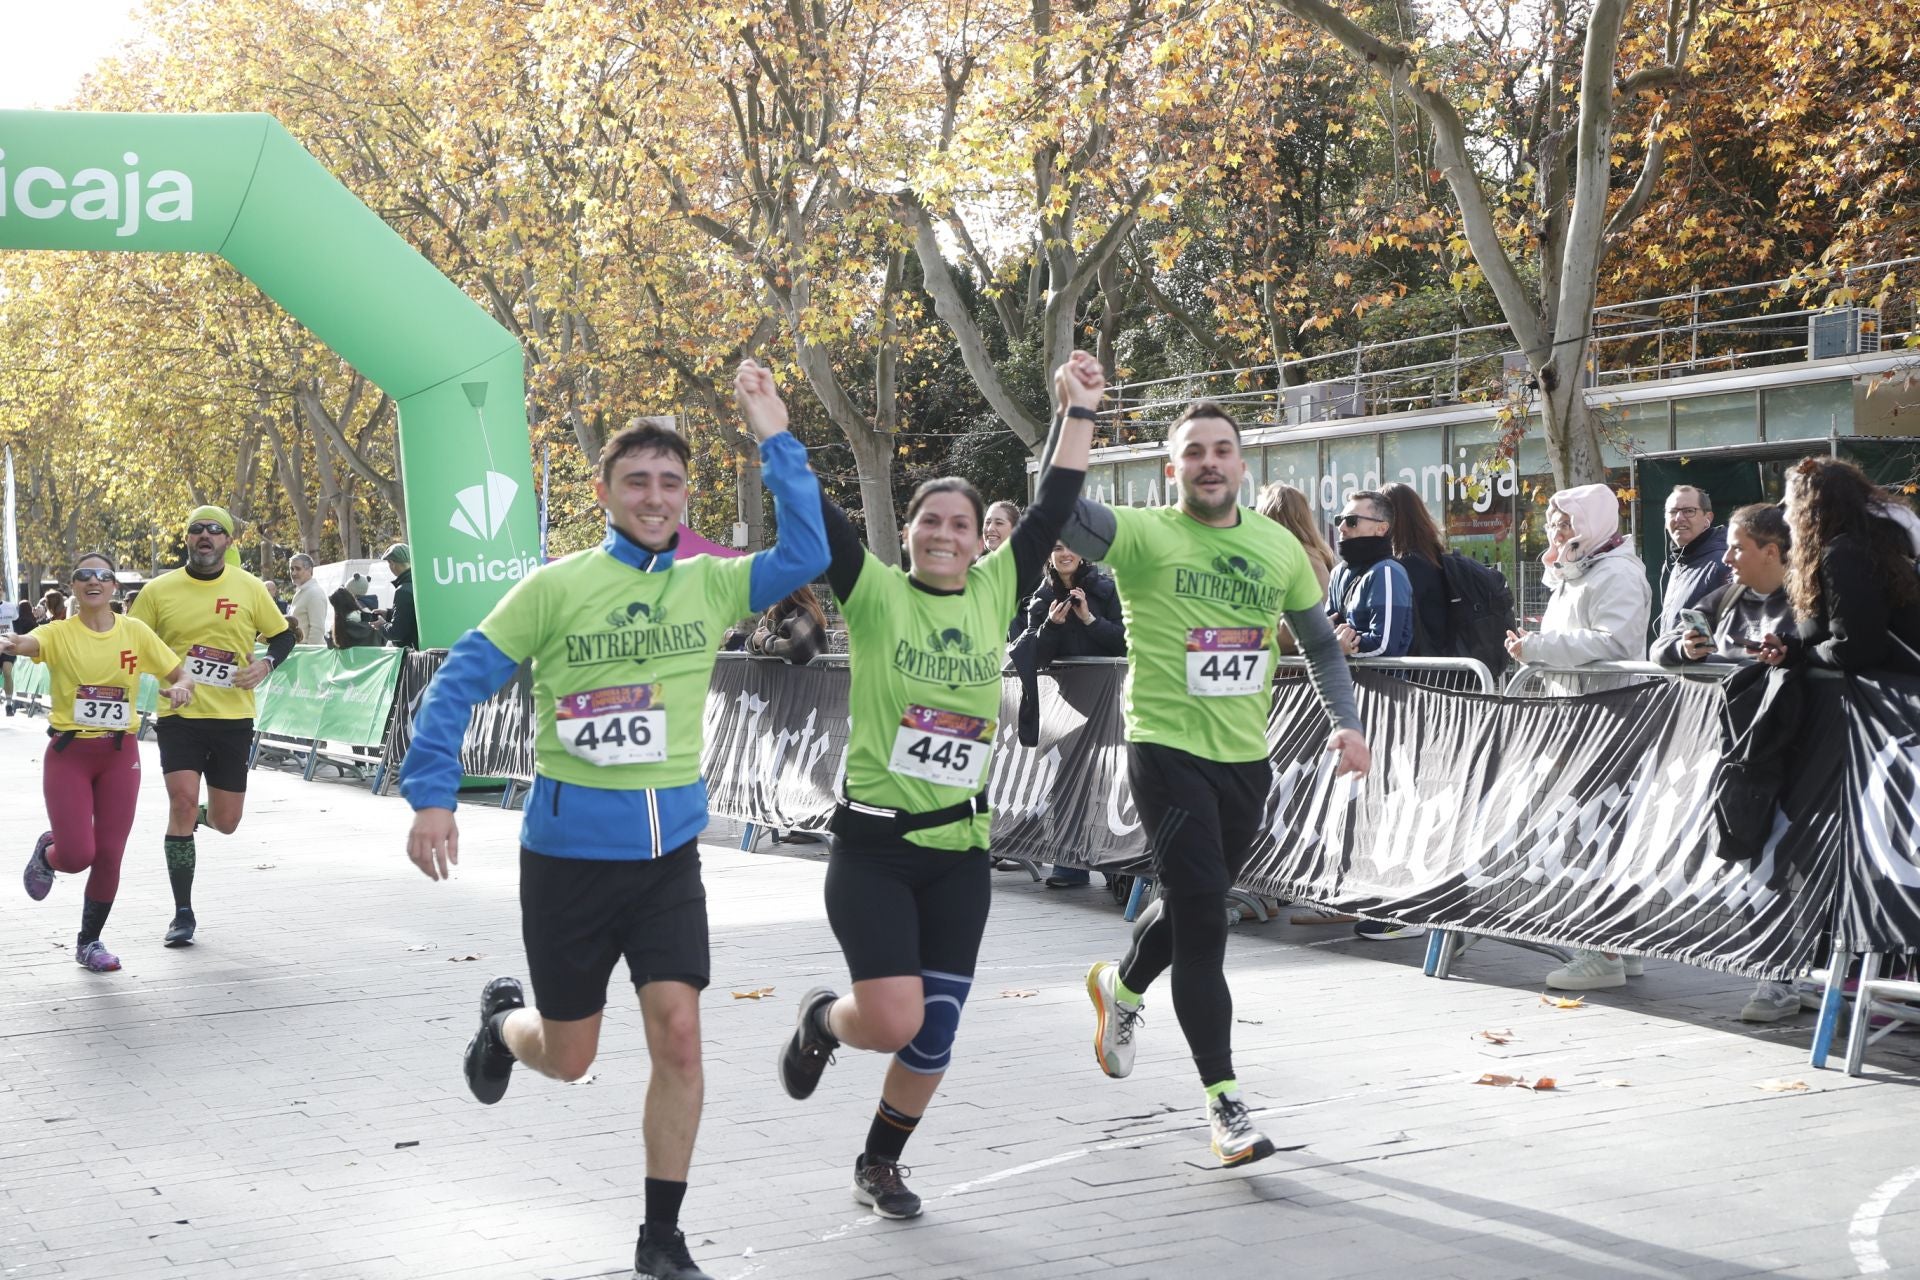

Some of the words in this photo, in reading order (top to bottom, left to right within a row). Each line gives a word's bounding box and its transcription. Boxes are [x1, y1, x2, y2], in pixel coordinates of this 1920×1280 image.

[565, 620, 707, 663] ENTREPINARES
[191, 659, 229, 680] 375
[1200, 655, 1259, 681] 447
[83, 701, 123, 720] 373
[574, 715, 651, 751] 446
[907, 736, 973, 771] 445
